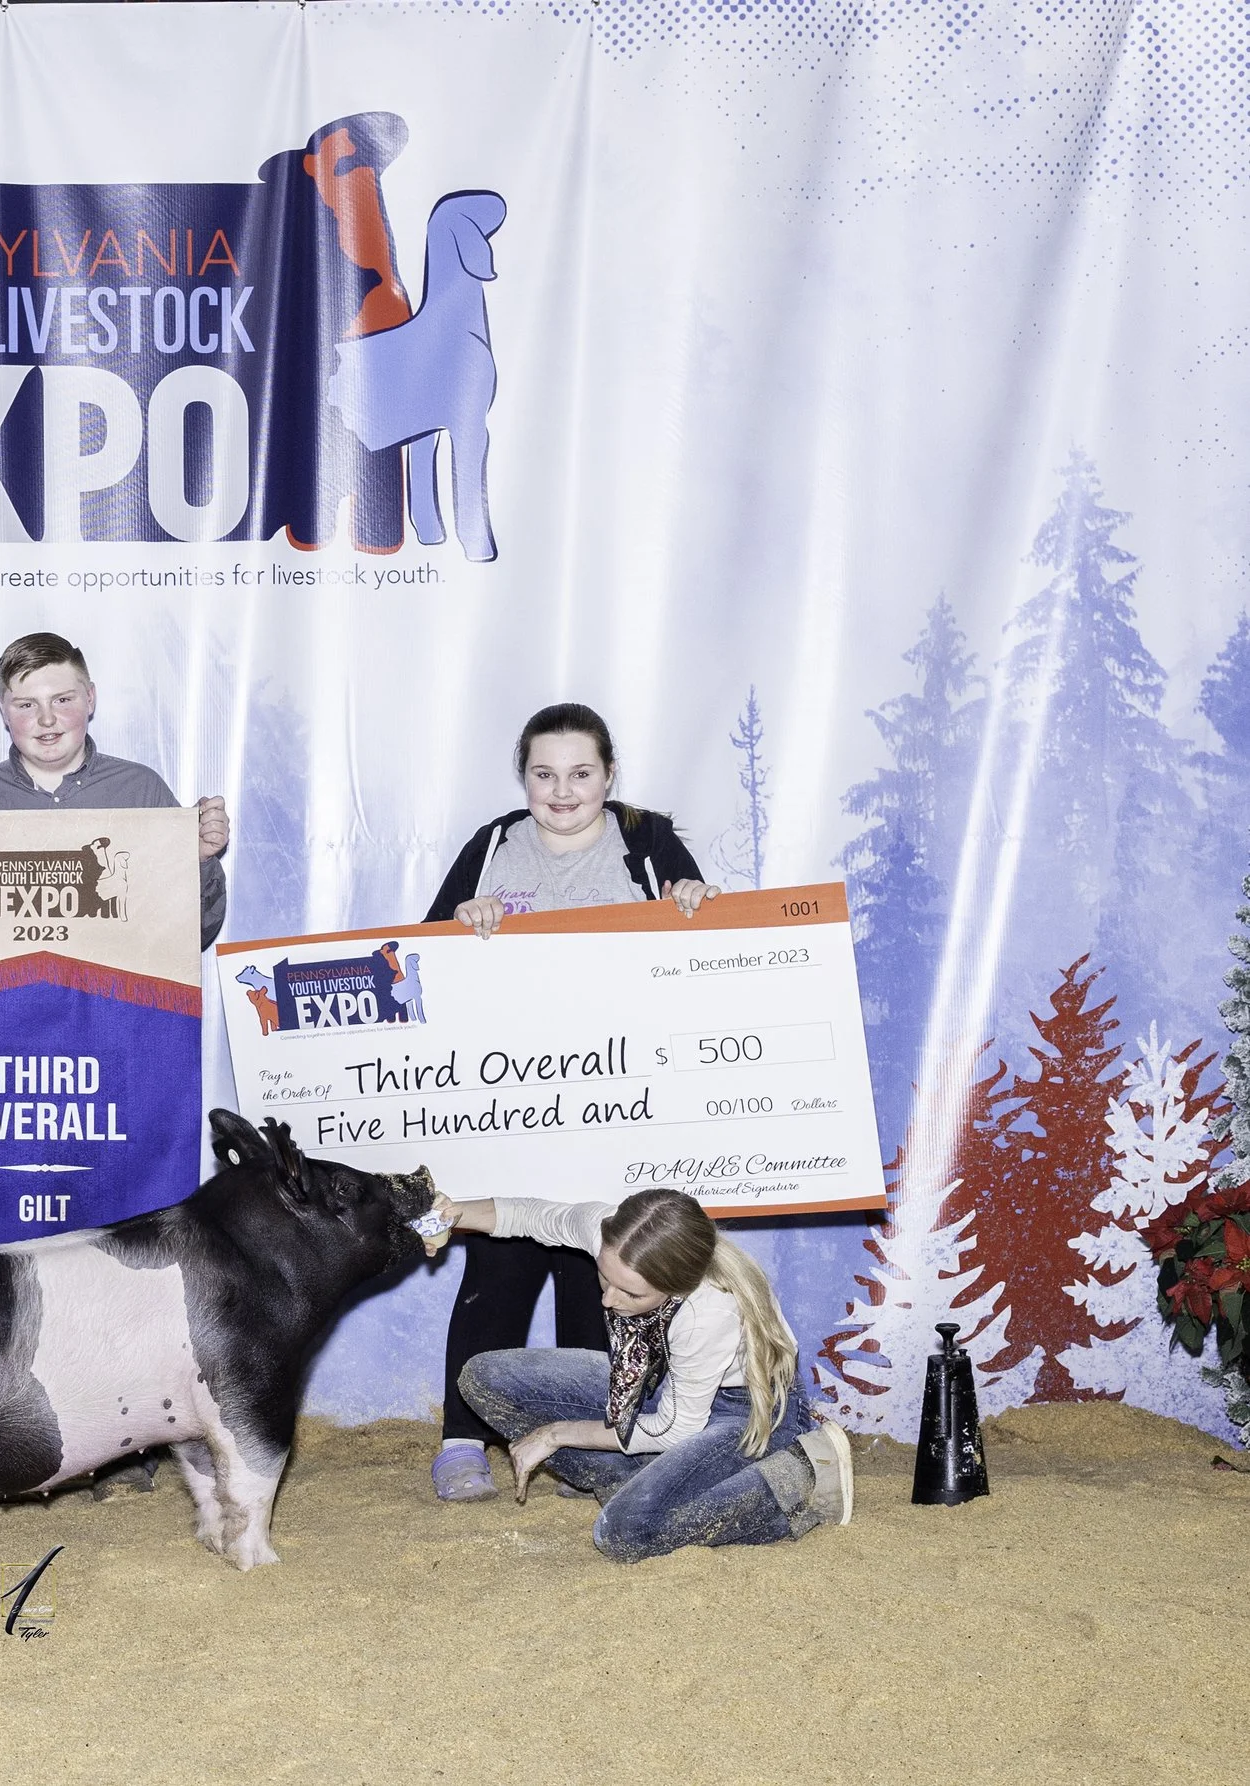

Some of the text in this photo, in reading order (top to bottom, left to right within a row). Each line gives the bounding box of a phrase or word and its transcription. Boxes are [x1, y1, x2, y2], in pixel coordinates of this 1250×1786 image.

[67, 566, 224, 592] opportunities
[232, 564, 264, 585] for
[272, 563, 367, 585] livestock
[374, 562, 446, 590] youth.
[30, 871, 84, 885] LIVESTOCK
[0, 885, 79, 918] EXPO
[780, 900, 819, 917] 1001
[13, 926, 69, 941] 2023
[287, 965, 371, 981] PENNSYLVANIA
[650, 948, 810, 978] Date December 2023
[288, 975, 376, 996] YOUTH LIVESTOCK
[295, 990, 379, 1030] EXPO
[655, 1035, 763, 1066] $ 500
[345, 1036, 627, 1094] Third Overall
[259, 1069, 294, 1085] Pay to
[262, 1084, 332, 1101] the Order Of
[318, 1087, 838, 1144] Five Hundred and 00/100 Dollars
[745, 1153, 848, 1175] Committee
[741, 1181, 800, 1198] Signature
[18, 1195, 71, 1222] GILT
